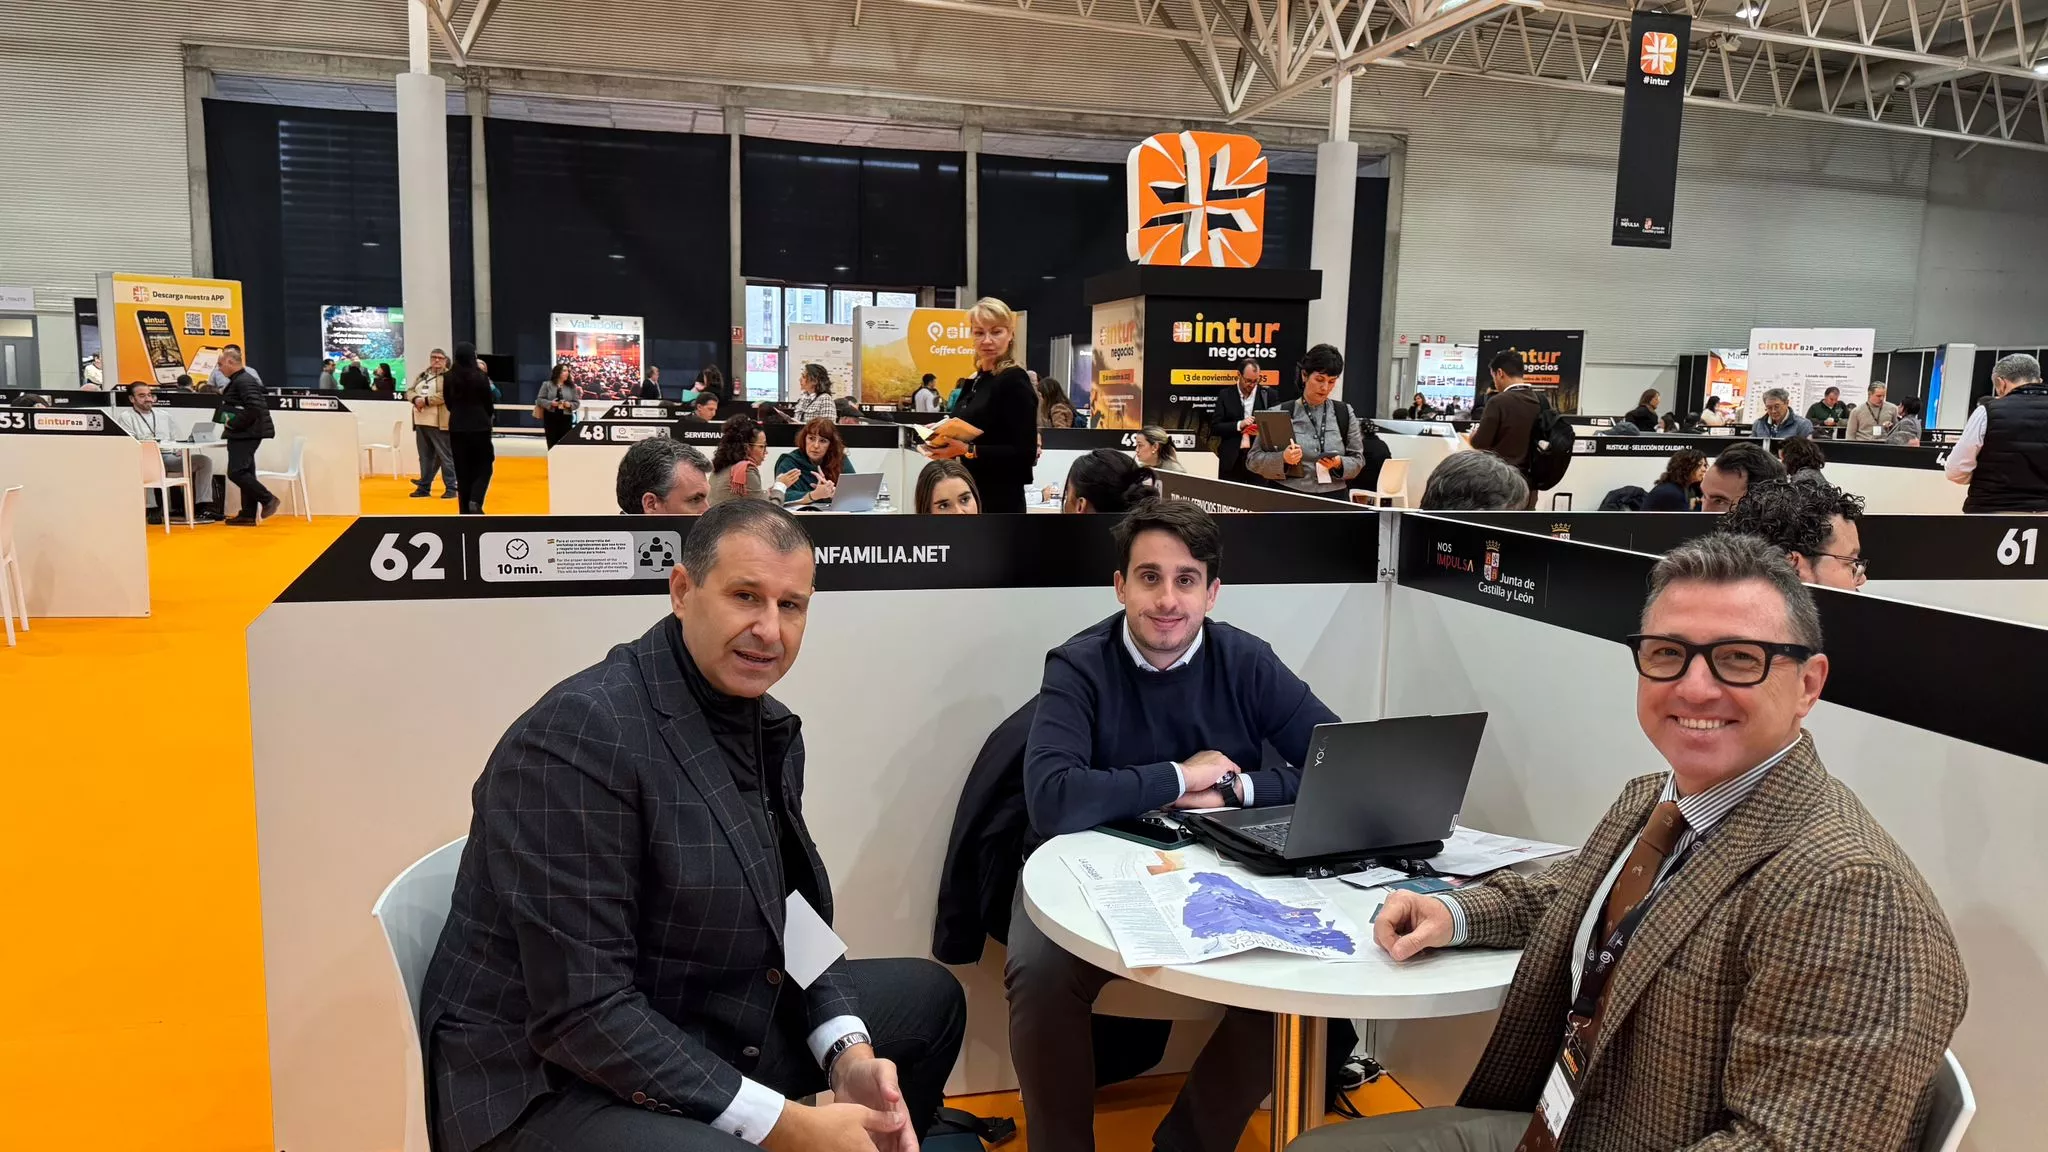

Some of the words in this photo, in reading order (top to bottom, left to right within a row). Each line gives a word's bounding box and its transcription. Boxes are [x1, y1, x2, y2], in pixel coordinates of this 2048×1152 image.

[1643, 76, 1670, 86] #intur
[152, 291, 183, 301] Descarga
[569, 319, 624, 330] Valladolid
[1195, 312, 1280, 344] intur
[930, 345, 956, 356] Coffee
[1766, 340, 1800, 350] intur
[1111, 344, 1134, 360] negocios
[1208, 344, 1277, 361] negocios
[1523, 363, 1559, 373] egocios
[1192, 373, 1201, 381] de
[1202, 373, 1238, 382] noviembre
[279, 398, 293, 408] 21
[614, 407, 628, 417] 26
[0, 412, 25, 429] 53
[579, 425, 605, 441] 48
[1931, 433, 1943, 442] 33
[1936, 452, 1947, 466] 4
[1437, 541, 1452, 553] NOS
[1997, 528, 2038, 565] 61
[370, 532, 445, 581] 62
[814, 545, 950, 564] NFAMILIA.NET
[497, 564, 513, 574] 10
[513, 564, 542, 574] min.
[1500, 573, 1523, 588] Junta
[1524, 578, 1535, 590] de
[1478, 581, 1505, 597] Castilla
[1506, 589, 1512, 602] y
[1514, 590, 1535, 604] León
